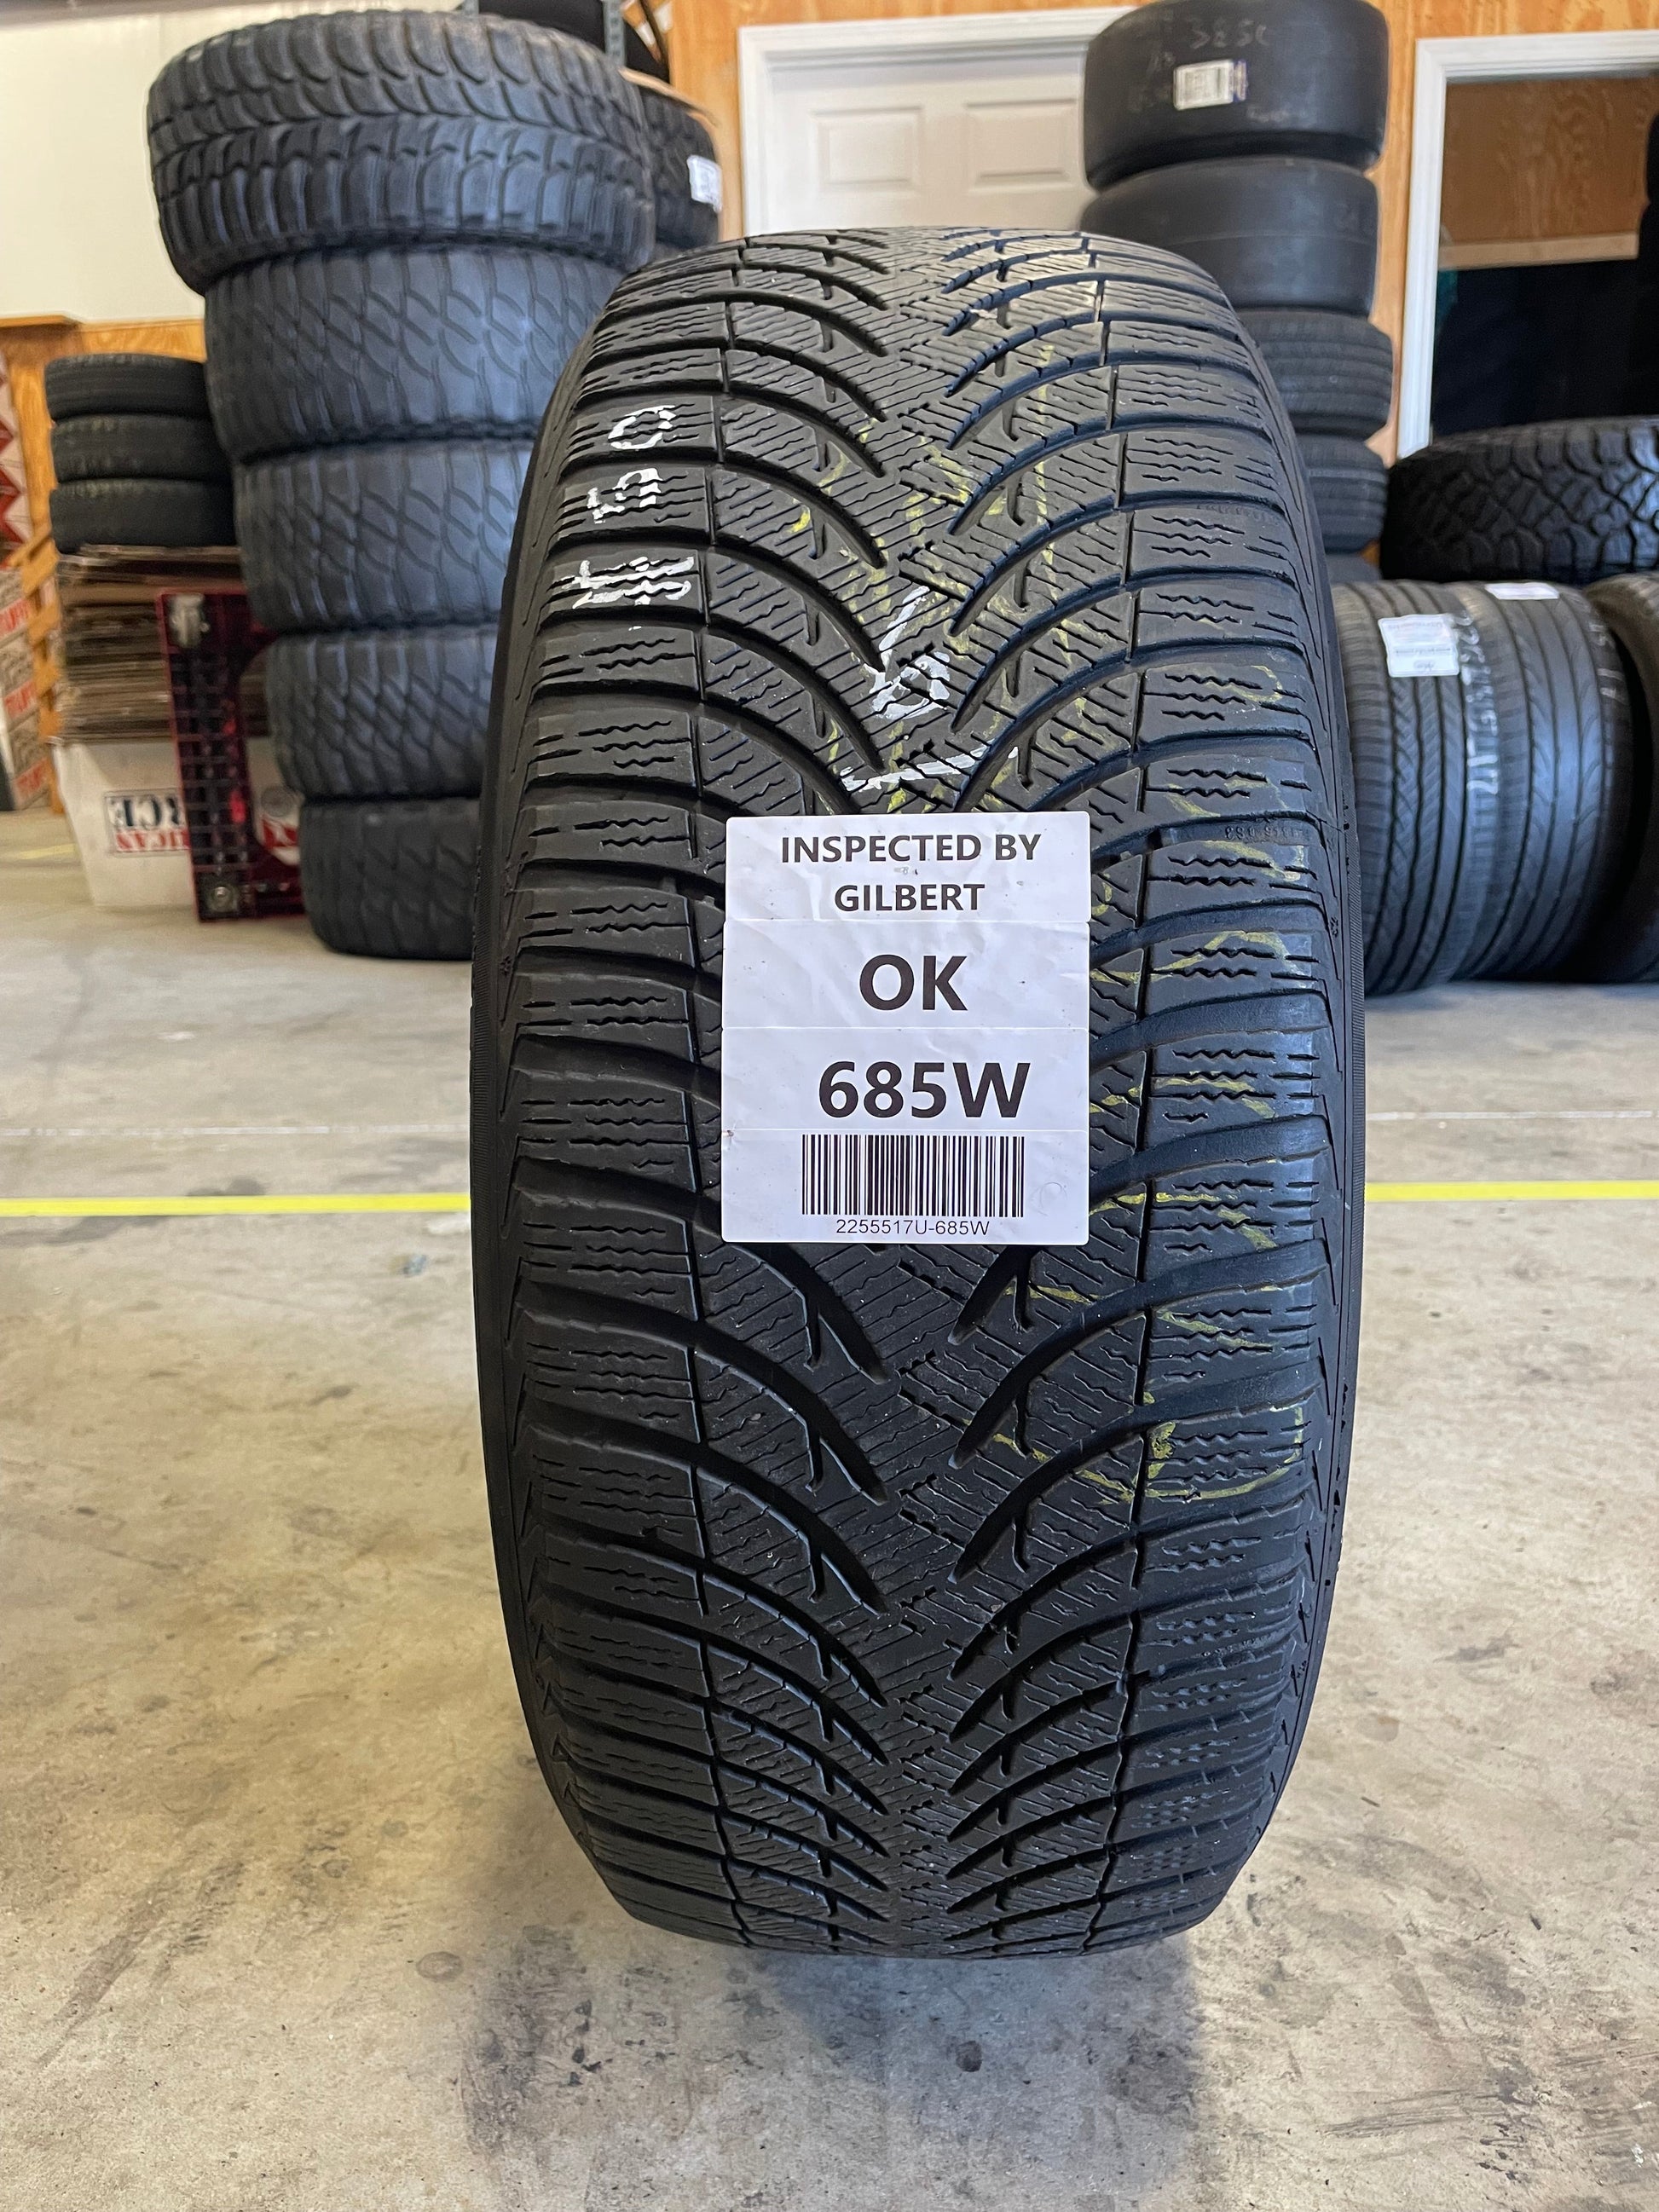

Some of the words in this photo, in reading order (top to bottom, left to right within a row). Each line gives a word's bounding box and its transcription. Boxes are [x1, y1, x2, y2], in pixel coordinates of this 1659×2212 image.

[782, 835, 981, 863] INSPECTED
[995, 834, 1041, 861] BY
[835, 883, 986, 912] GILBERT
[859, 954, 968, 1011] OK
[818, 1060, 1031, 1118] 685W
[835, 1219, 990, 1236] 2255517U-685W
